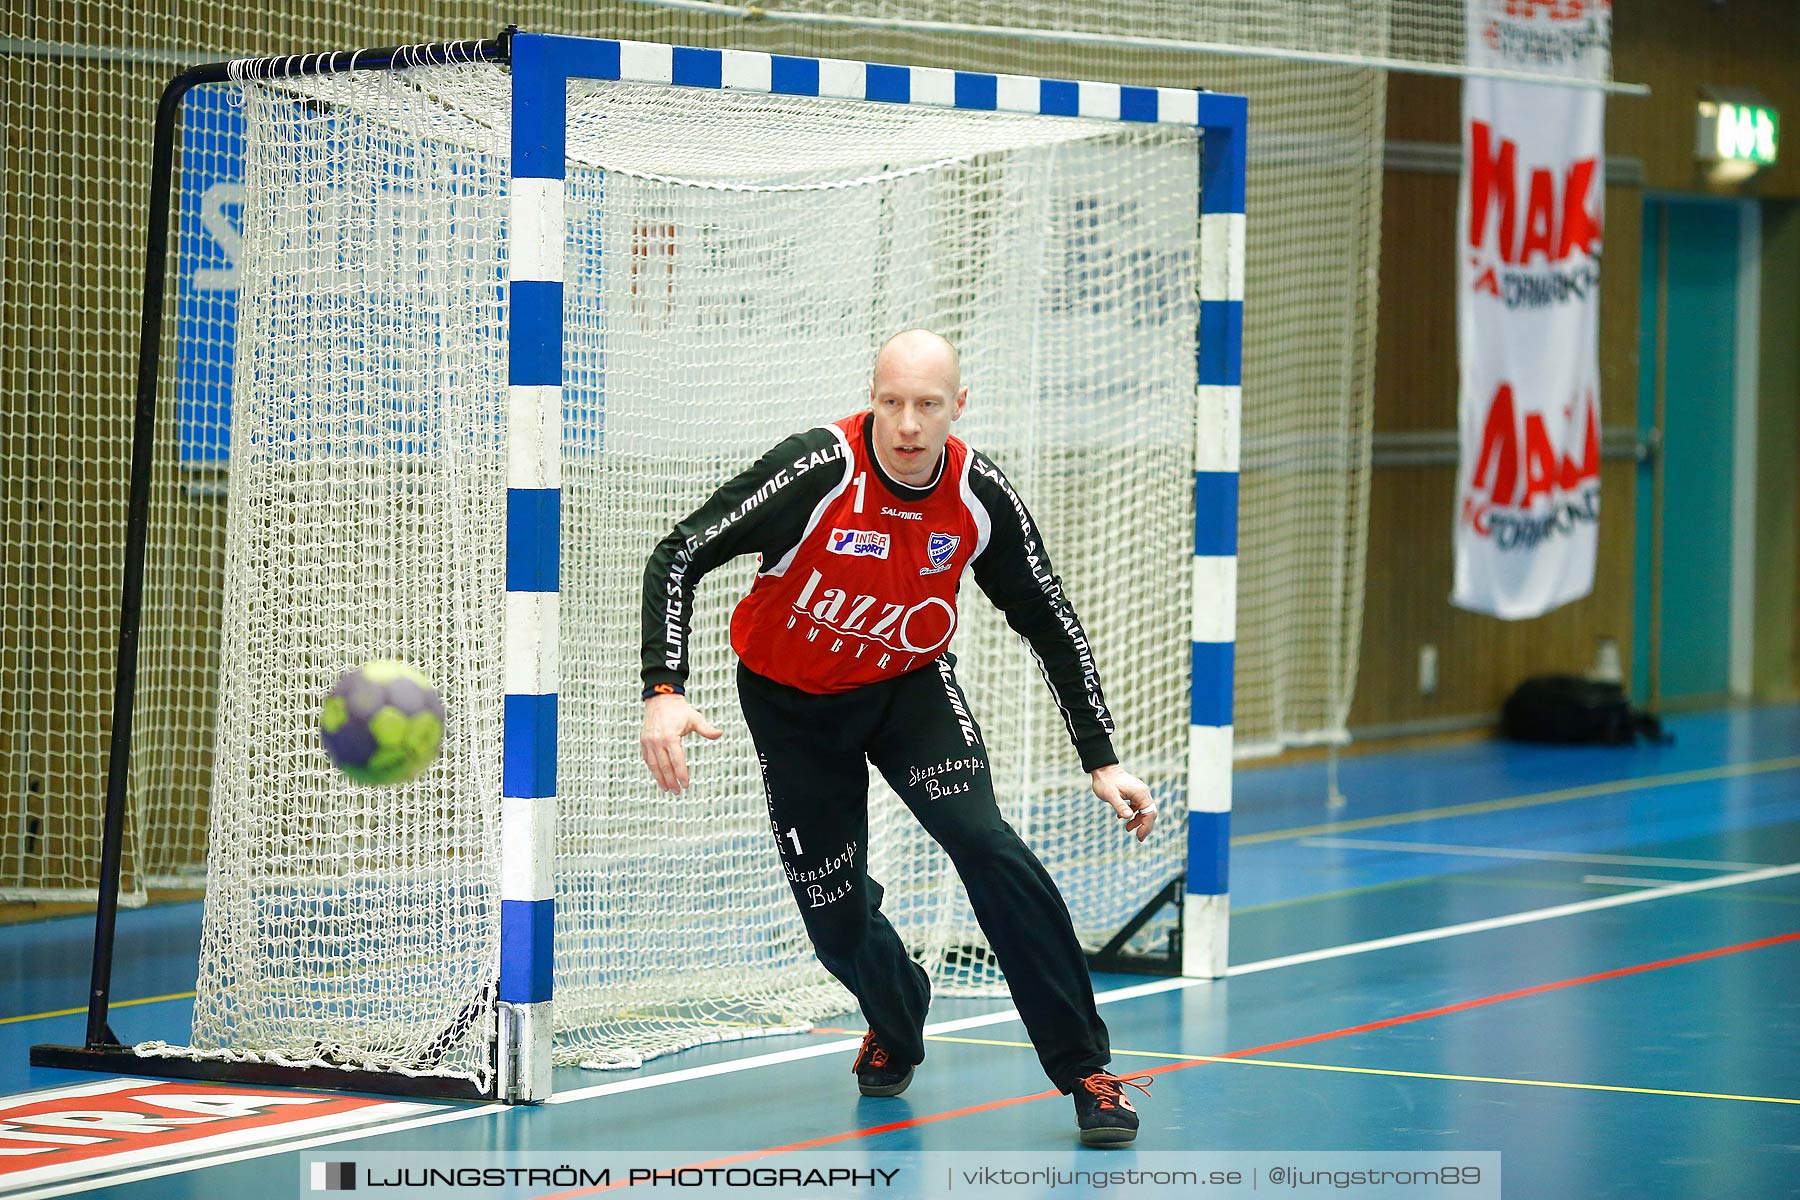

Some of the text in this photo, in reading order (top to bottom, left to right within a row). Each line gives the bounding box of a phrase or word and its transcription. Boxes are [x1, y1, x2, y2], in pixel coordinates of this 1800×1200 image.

[852, 471, 867, 514] 1
[854, 543, 885, 556] SPORT
[855, 533, 887, 547] INTER
[908, 756, 985, 787] Stenstorps
[925, 779, 970, 801] Buss
[786, 827, 804, 856] 1
[784, 840, 857, 883] Stenstorps
[806, 879, 853, 909] Buss
